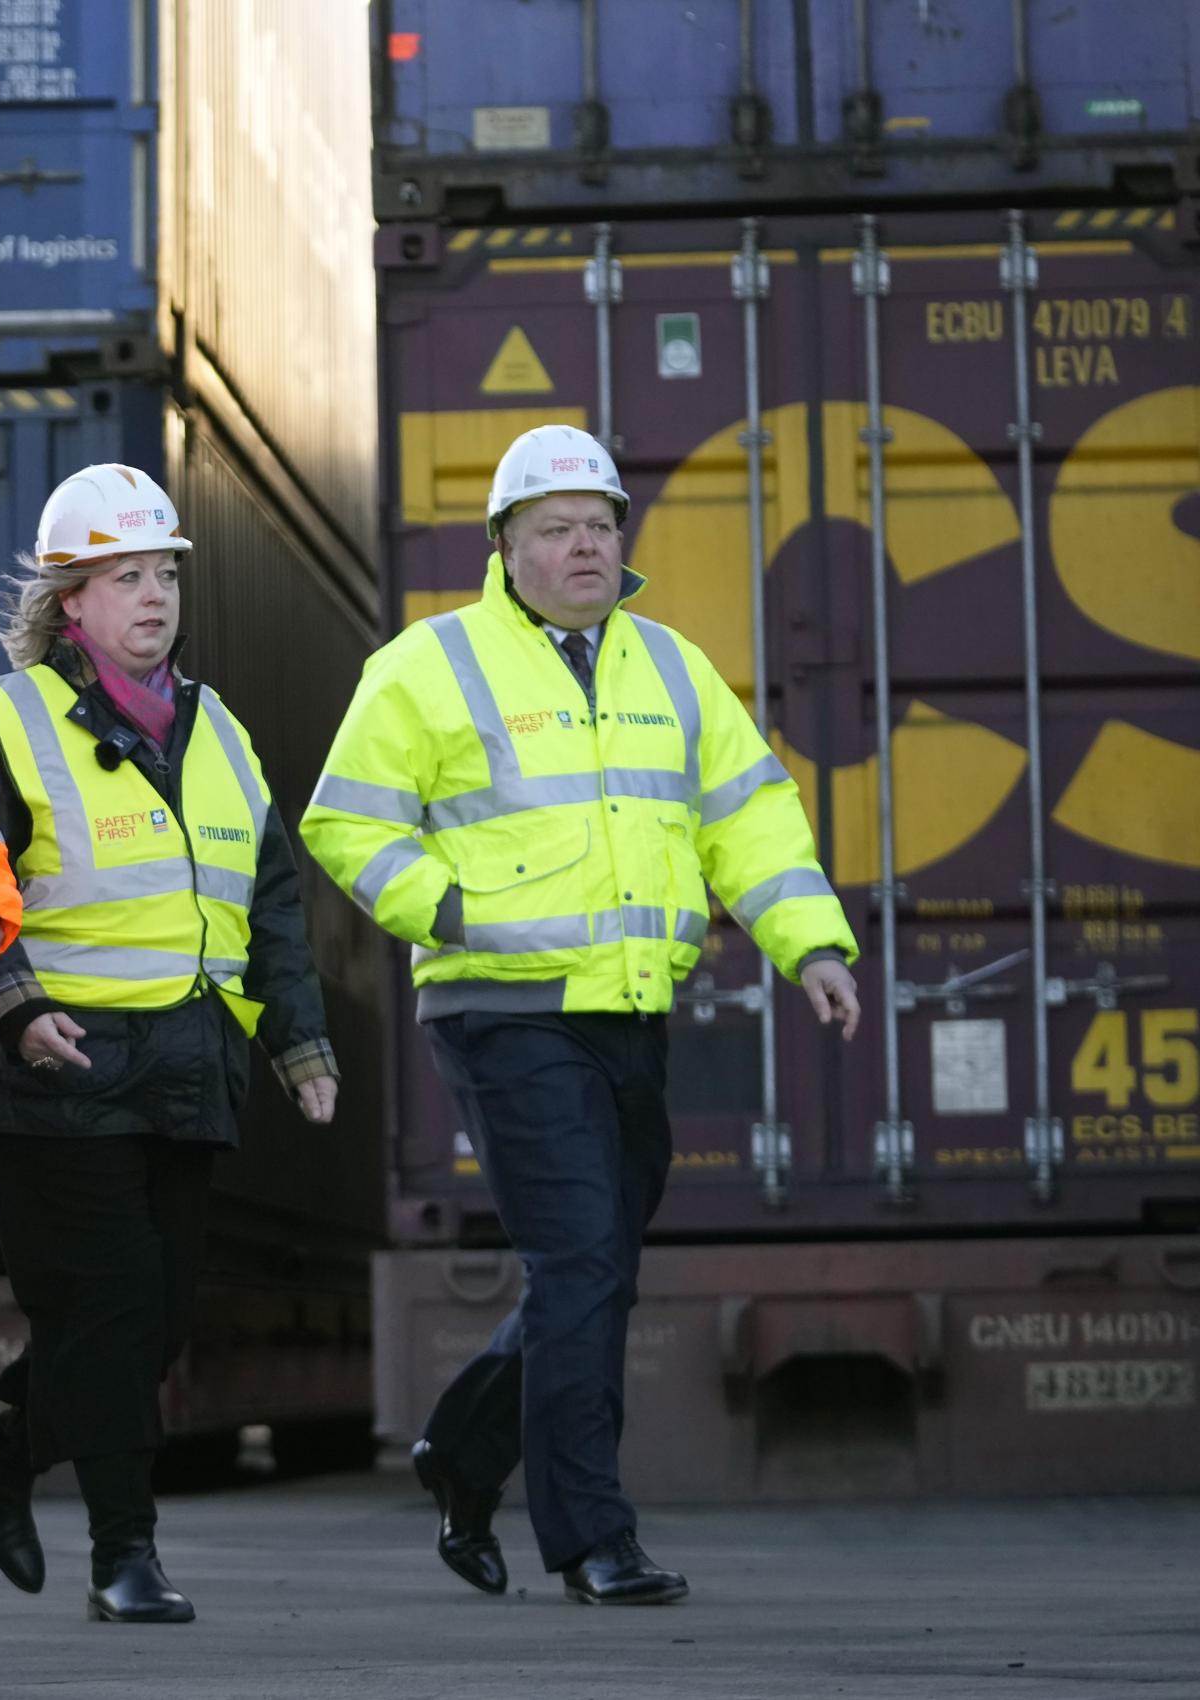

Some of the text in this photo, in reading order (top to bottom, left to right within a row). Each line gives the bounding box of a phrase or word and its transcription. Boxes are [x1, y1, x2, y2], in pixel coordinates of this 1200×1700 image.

[18, 235, 118, 268] logistics
[926, 296, 1189, 342] ECBU 470079 4
[1036, 346, 1119, 386] LEVA
[552, 457, 585, 466] SAFETY
[117, 509, 151, 521] SAFETY
[504, 710, 553, 725] SAFETY
[95, 811, 146, 829] SAFETY
[205, 826, 251, 844] TILBURY2
[1071, 1007, 1199, 1109] 45
[1072, 1114, 1199, 1143] ECS.BE
[969, 1313, 1071, 1346] CNEU
